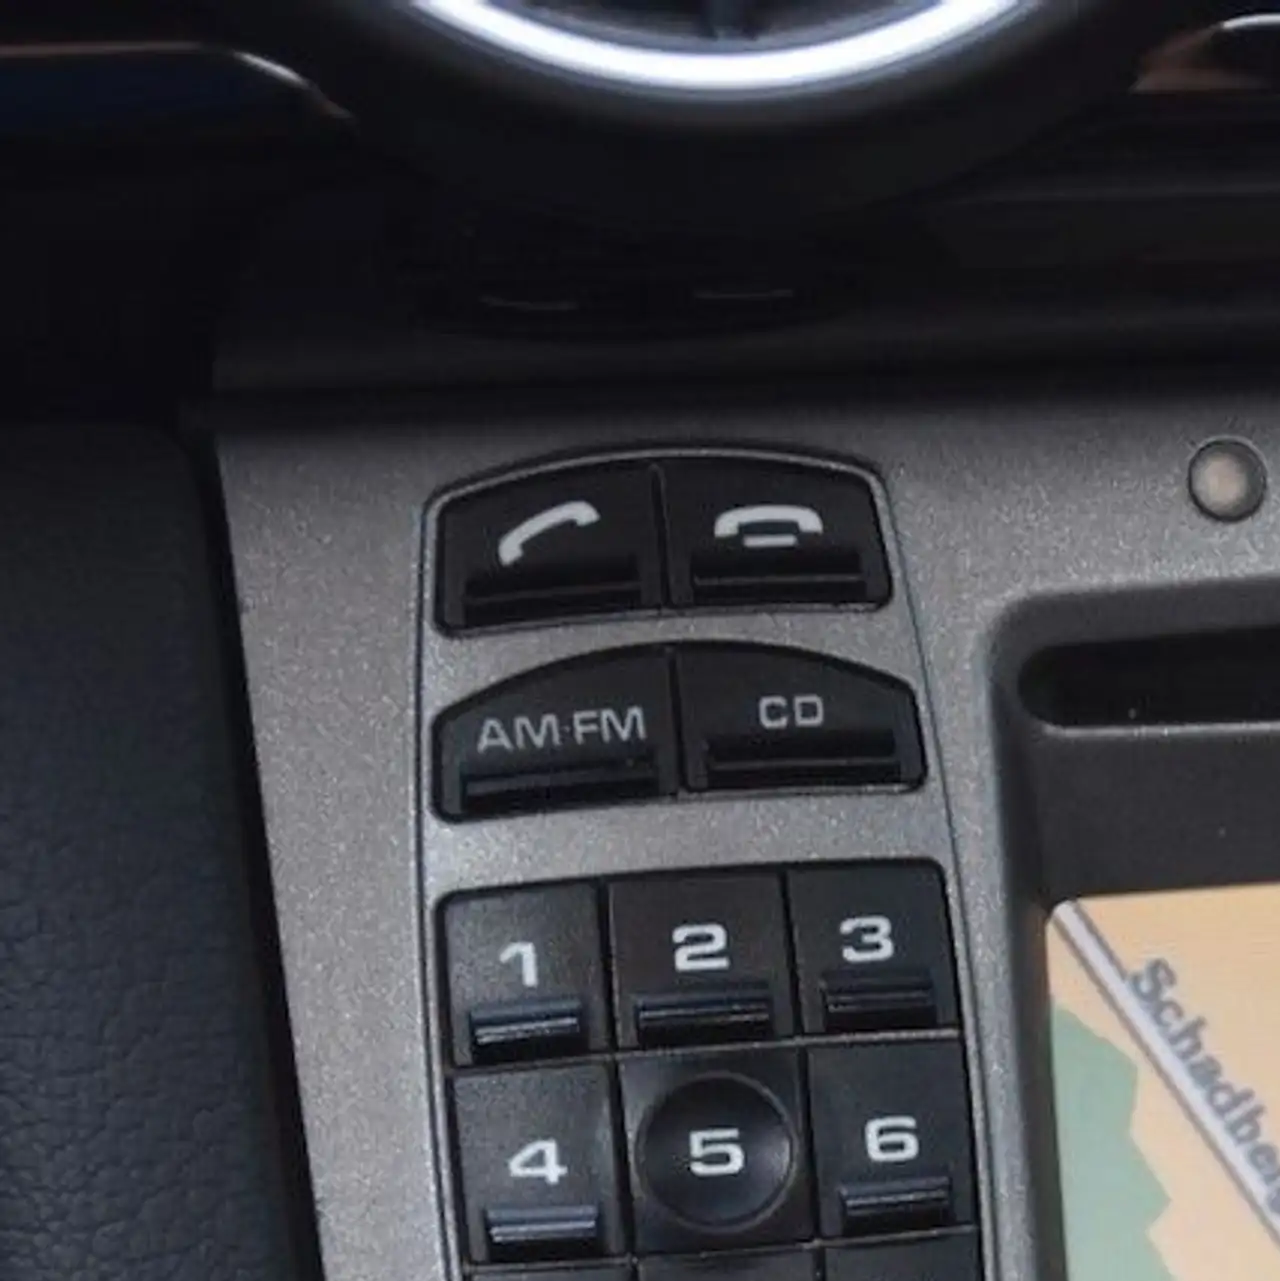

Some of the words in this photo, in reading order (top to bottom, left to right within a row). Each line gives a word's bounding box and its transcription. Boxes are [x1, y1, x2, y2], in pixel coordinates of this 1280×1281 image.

[758, 693, 825, 730] CD
[672, 923, 730, 972] 2
[839, 915, 895, 963] 3
[498, 941, 538, 987] 1
[507, 1139, 568, 1185] 4
[689, 1128, 745, 1176] 5
[864, 1116, 919, 1163] 6
